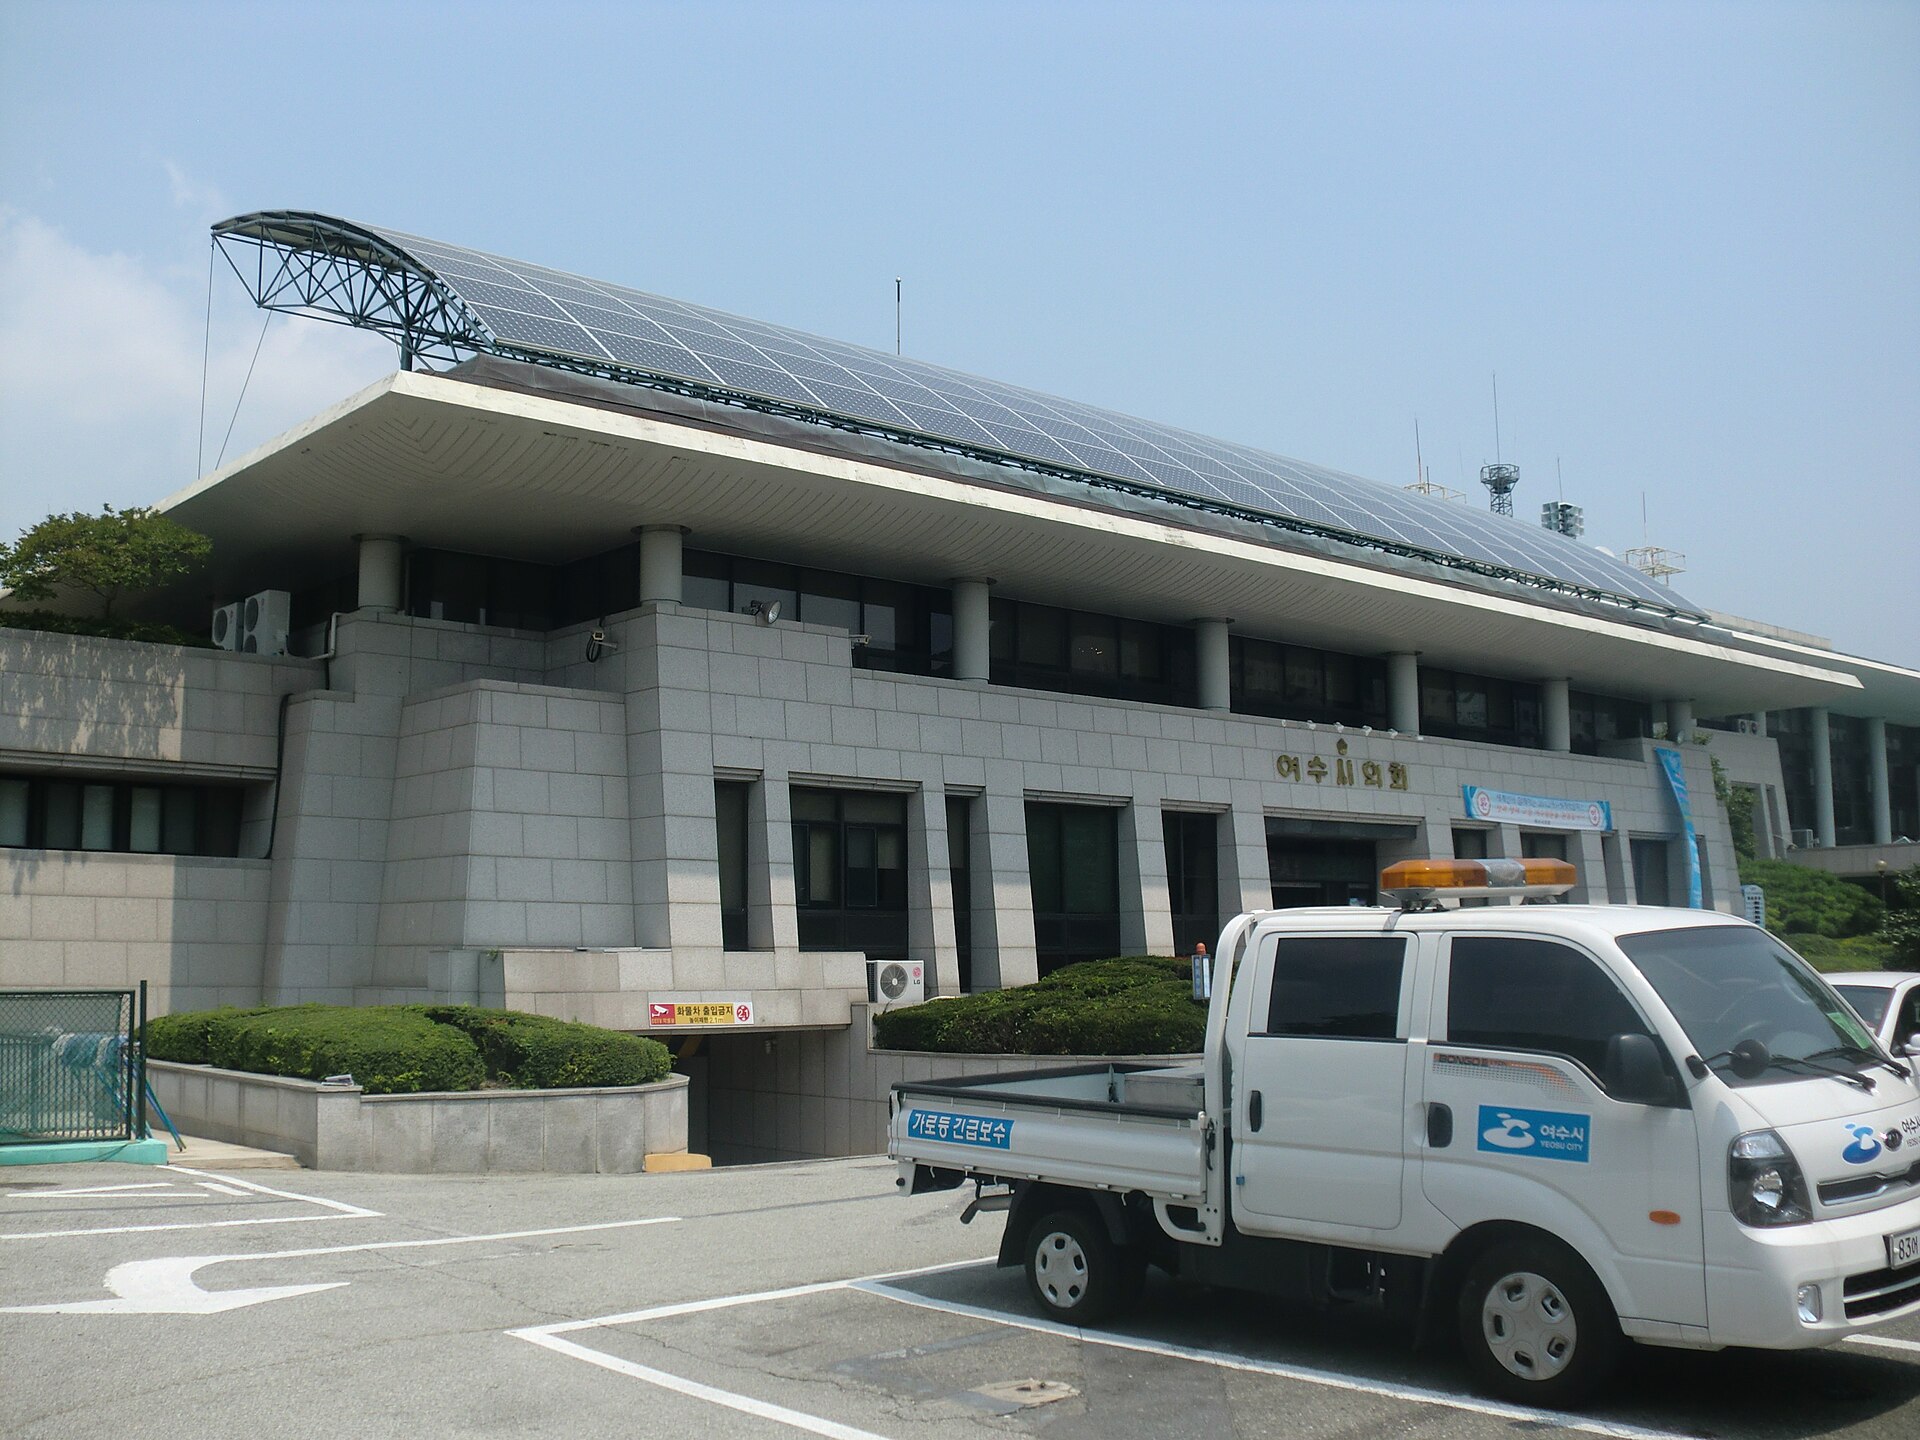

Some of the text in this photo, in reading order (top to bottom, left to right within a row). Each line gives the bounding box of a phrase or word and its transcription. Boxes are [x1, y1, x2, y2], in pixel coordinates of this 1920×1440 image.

[1277, 738, 1408, 790] 여수시의회
[677, 1005, 733, 1016] 화물차 출입금지
[912, 1113, 1006, 1144] 가로등 긴급보수
[1540, 1124, 1584, 1142] 여수시
[1540, 1140, 1583, 1151] YEOSU CITY
